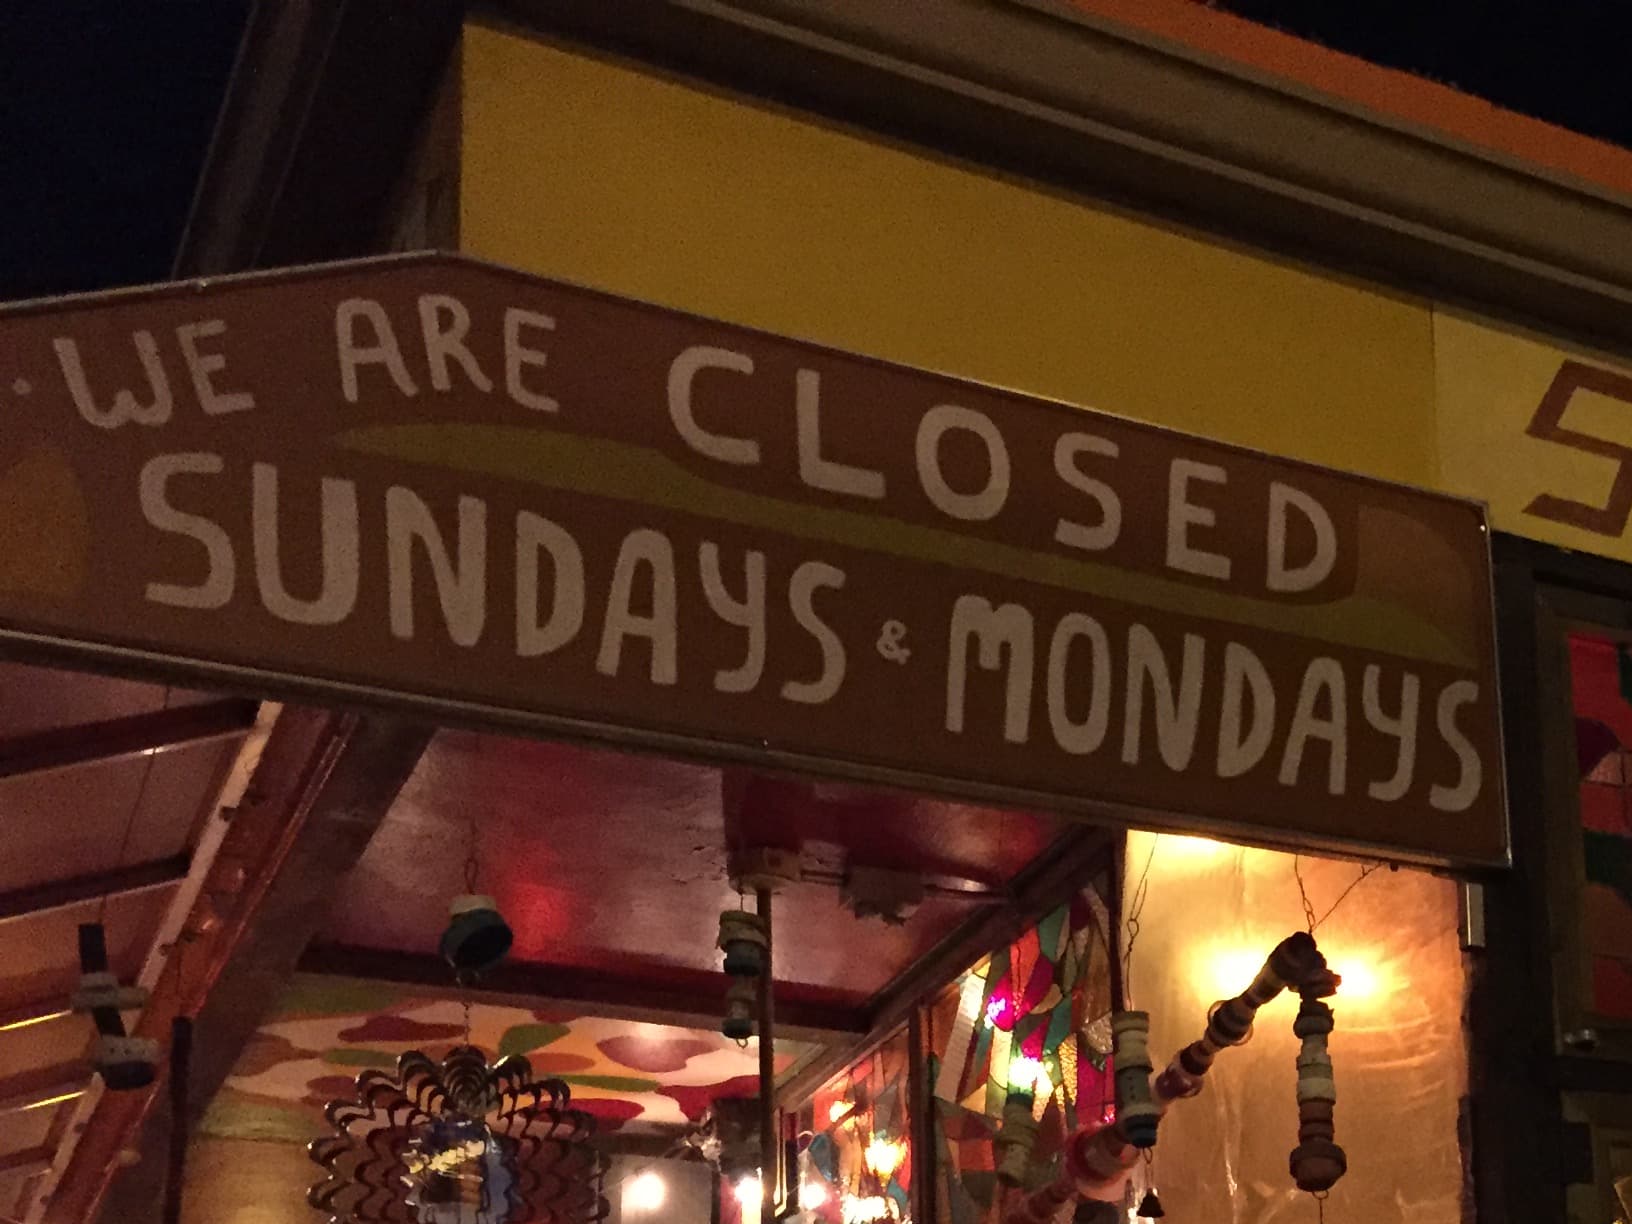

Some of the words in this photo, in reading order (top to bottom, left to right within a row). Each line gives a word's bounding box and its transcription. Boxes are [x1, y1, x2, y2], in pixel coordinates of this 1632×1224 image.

[53, 318, 255, 430] WE
[334, 294, 560, 414] ARE
[666, 345, 1339, 593] CLOSED
[137, 452, 847, 706] SUNDAYS
[875, 619, 912, 666] &
[944, 594, 1483, 813] MONDAYS
